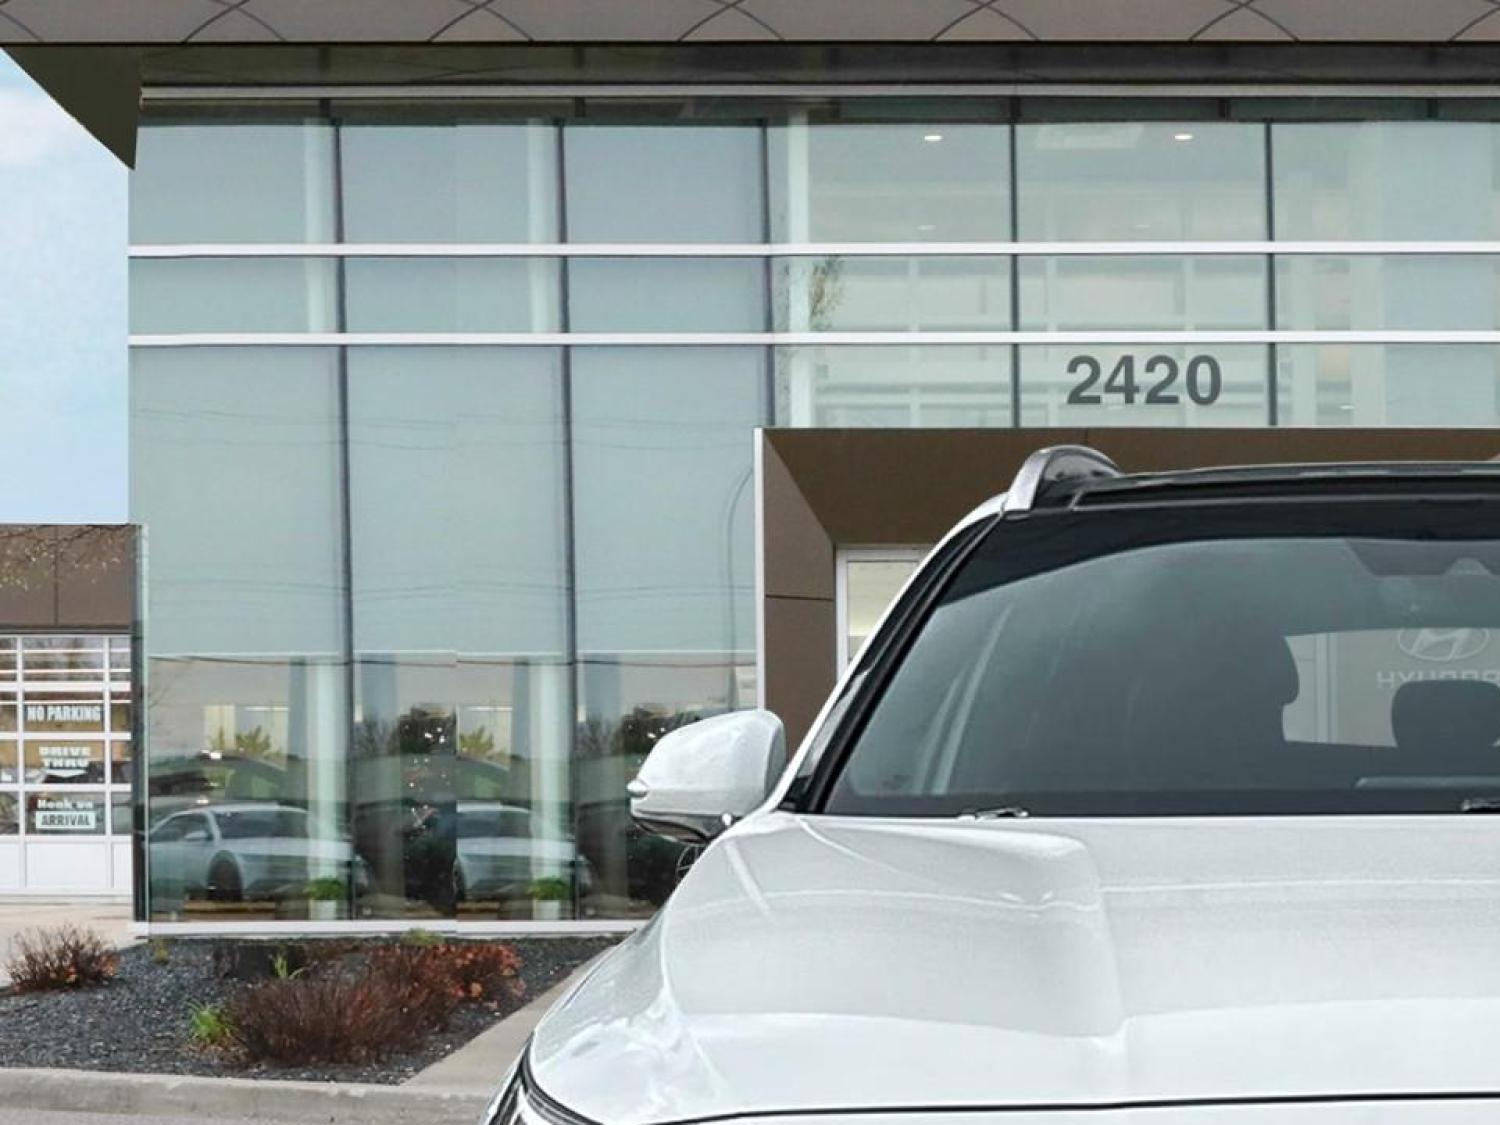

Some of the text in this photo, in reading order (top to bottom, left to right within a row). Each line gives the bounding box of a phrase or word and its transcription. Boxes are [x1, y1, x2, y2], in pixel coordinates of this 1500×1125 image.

[1066, 354, 1222, 406] 2420
[27, 705, 101, 721] NO PARKING
[38, 746, 91, 756] DRIVE
[43, 758, 89, 768] THRU
[41, 814, 91, 826] ARRIVAL
